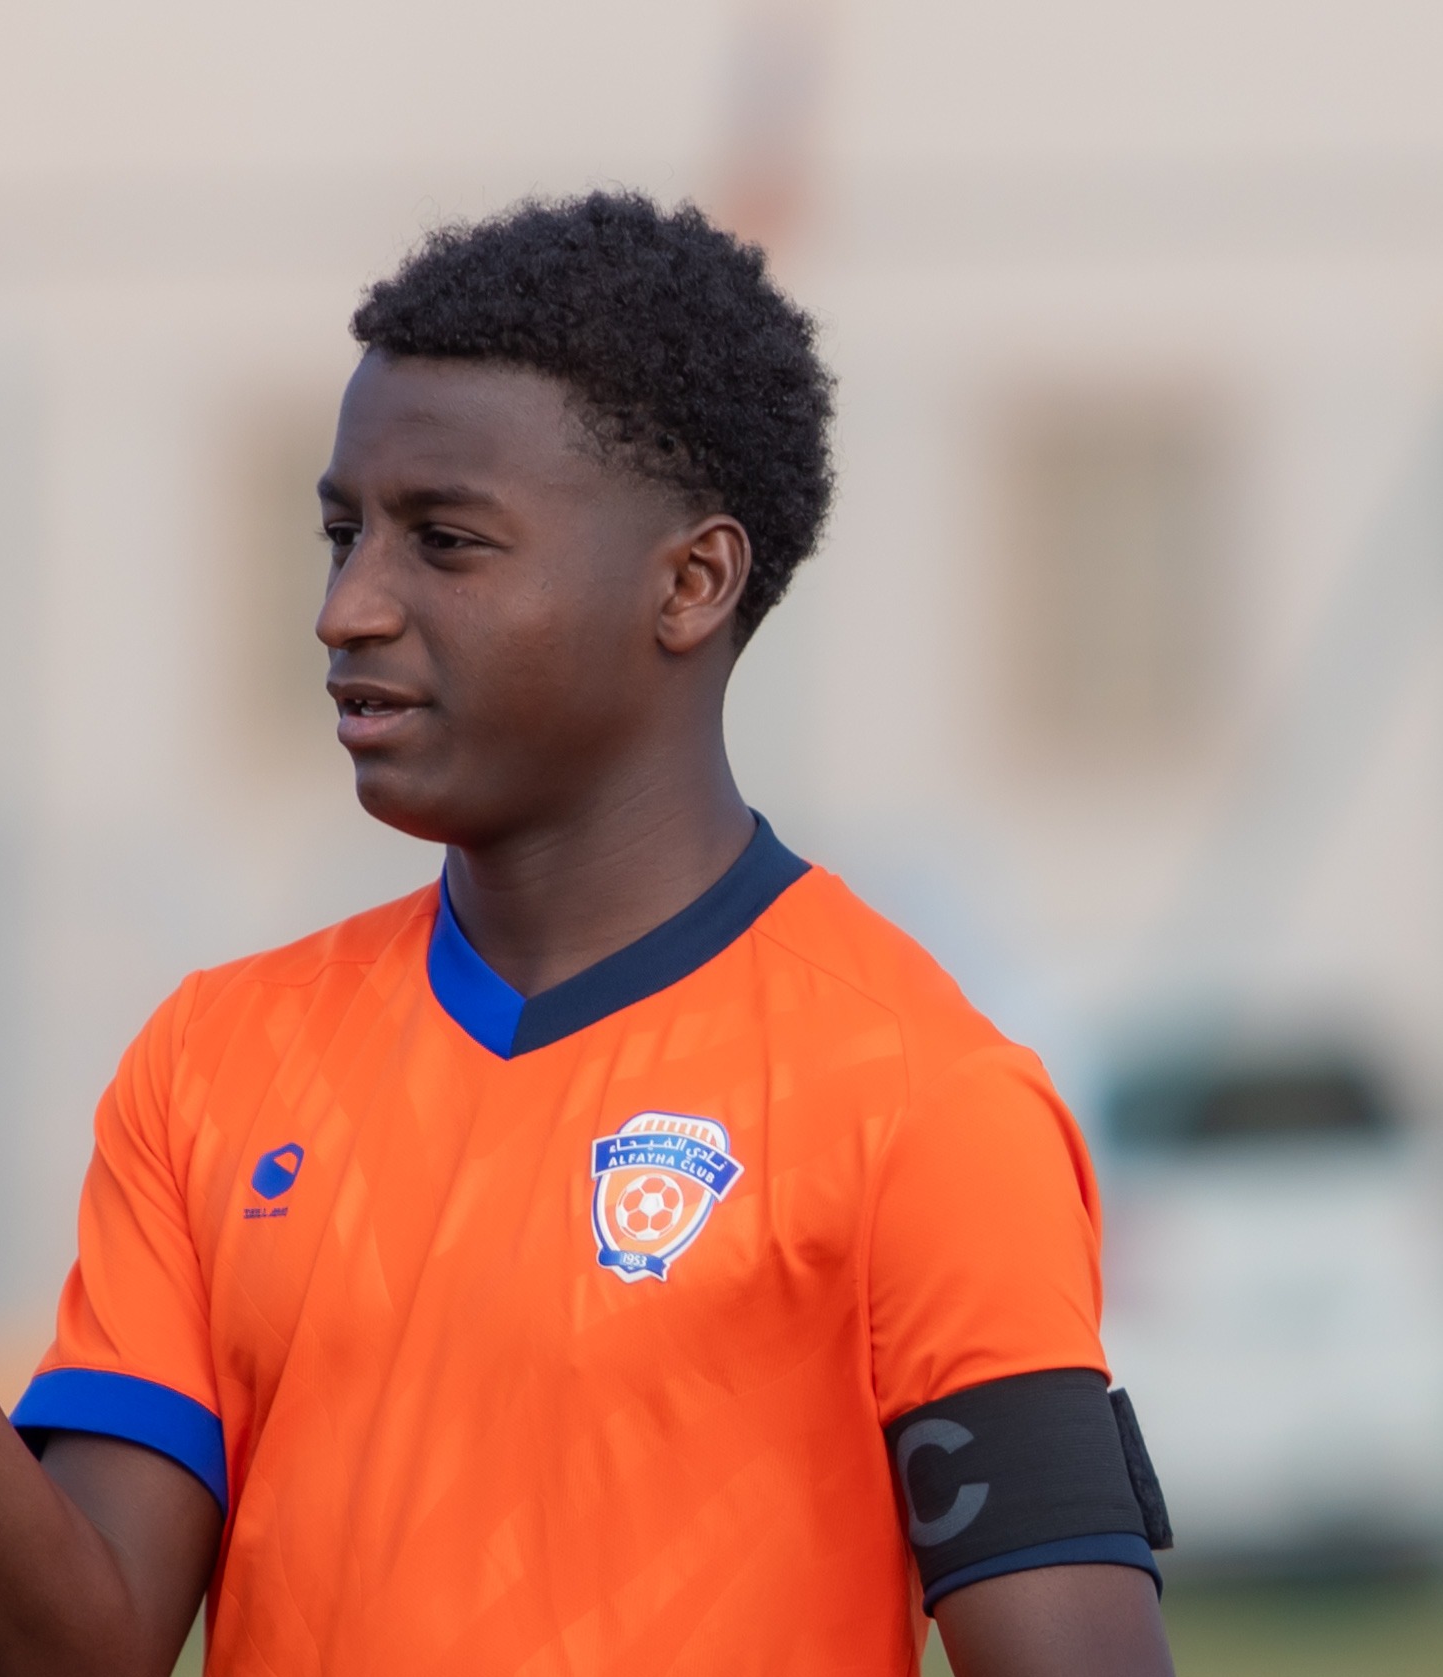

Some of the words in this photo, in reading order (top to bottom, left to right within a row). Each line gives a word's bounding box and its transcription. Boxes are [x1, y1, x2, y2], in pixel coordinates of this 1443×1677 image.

[608, 1152, 675, 1168] ALFAYHA
[680, 1158, 716, 1184] CLUB
[622, 1252, 648, 1267] 1953
[896, 1418, 989, 1546] C
